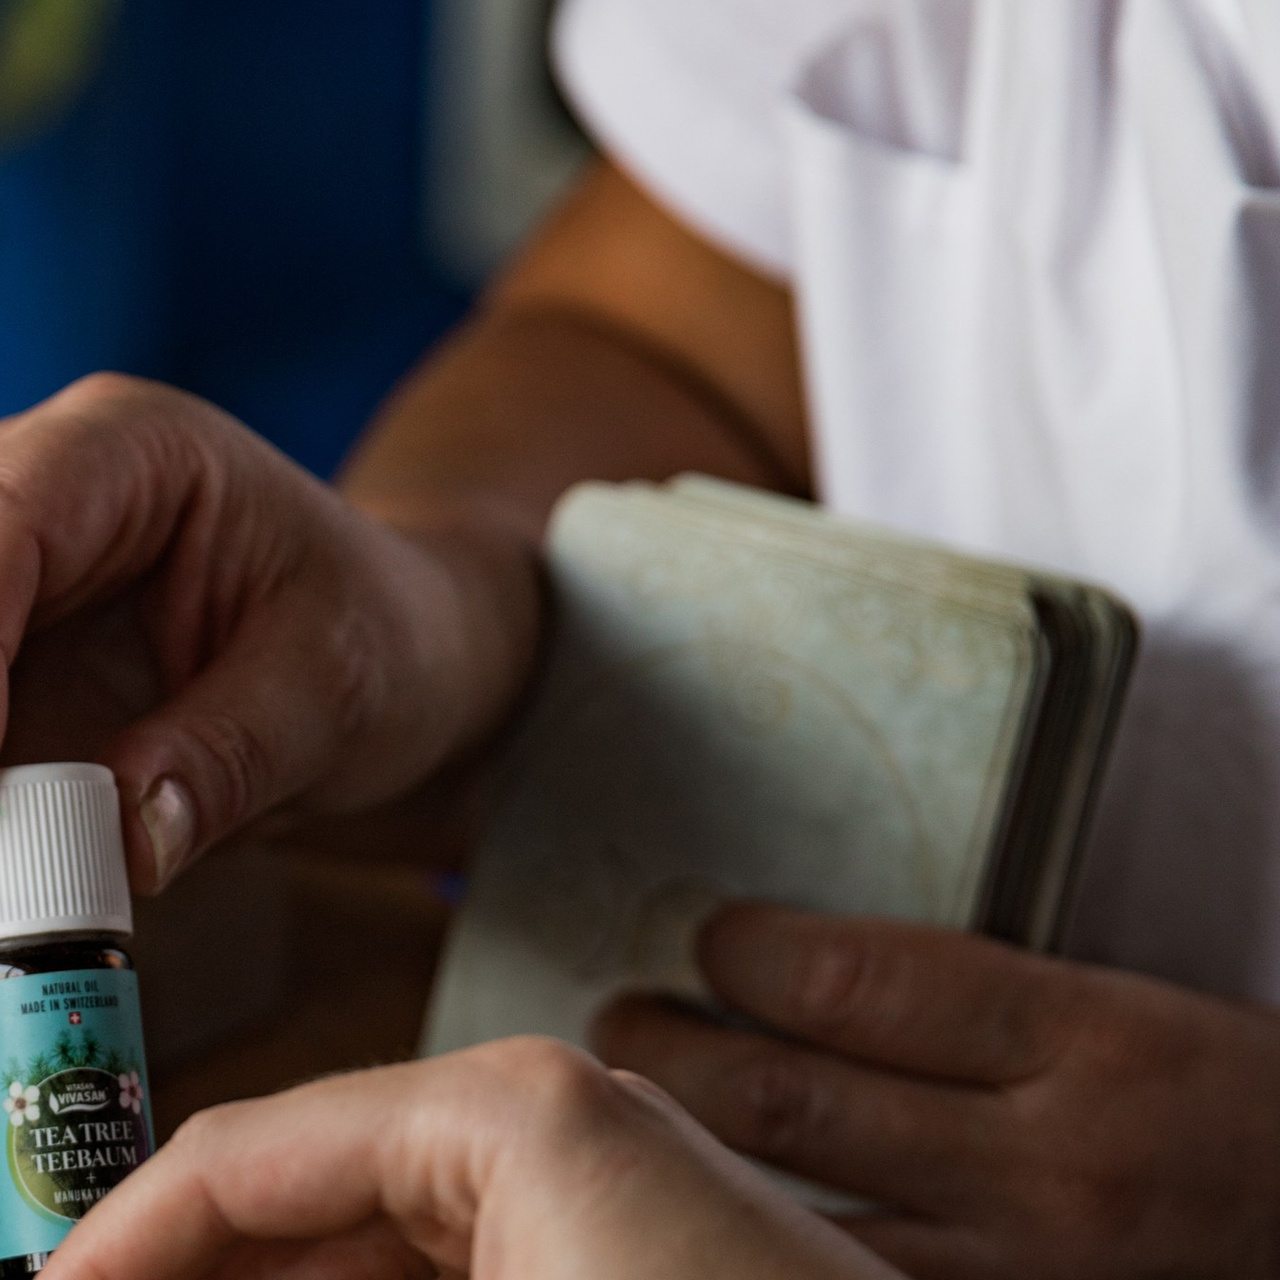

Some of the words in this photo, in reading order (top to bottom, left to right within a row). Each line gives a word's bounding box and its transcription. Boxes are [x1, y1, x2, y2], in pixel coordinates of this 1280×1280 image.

[42, 981, 81, 996] NATURAL
[84, 980, 99, 992] OIL
[21, 1000, 45, 1014] MADE
[50, 999, 59, 1011] IN
[64, 996, 118, 1010] SWITZERLAND
[58, 1090, 107, 1104] VIVASAN
[29, 1125, 77, 1148] TEA
[79, 1121, 134, 1142] TREE
[30, 1146, 137, 1173] TEEBAUM
[54, 1188, 93, 1204] MANUKA
